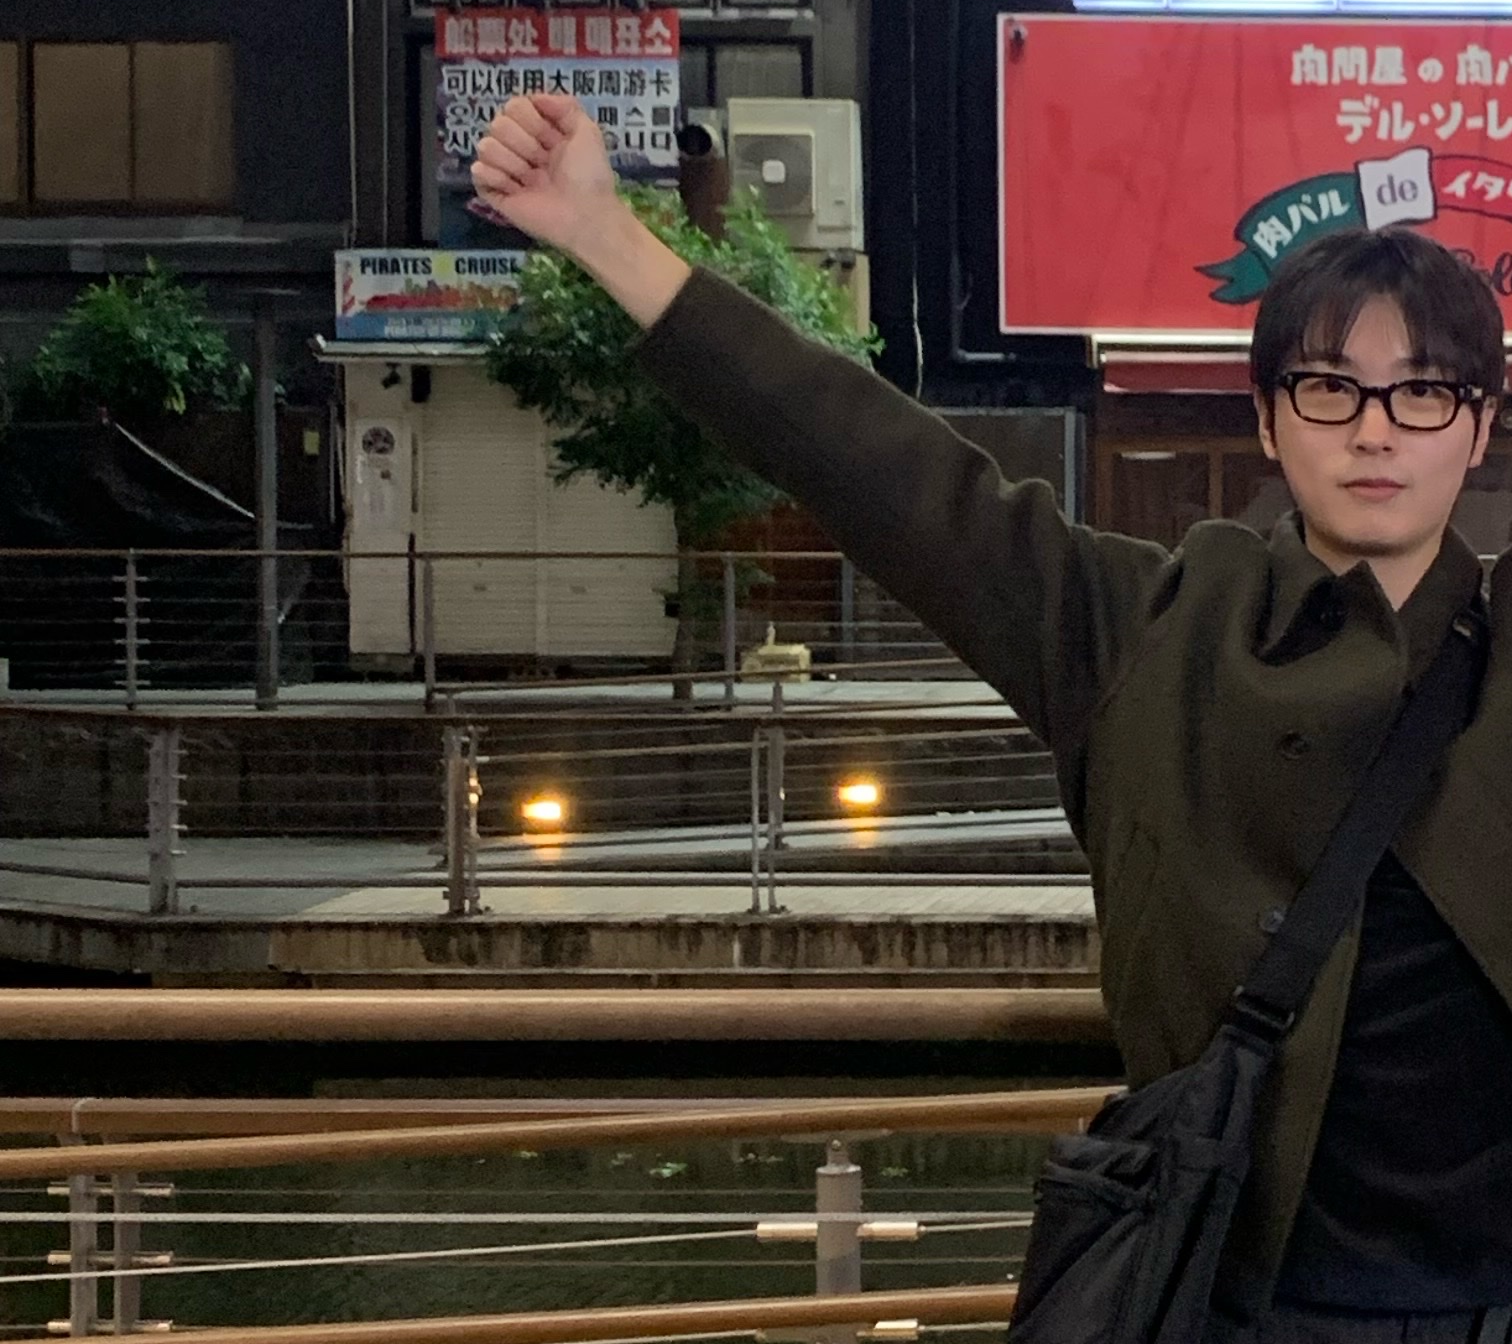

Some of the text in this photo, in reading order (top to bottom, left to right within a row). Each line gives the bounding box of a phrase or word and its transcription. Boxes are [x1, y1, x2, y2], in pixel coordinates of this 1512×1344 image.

[446, 69, 672, 97] 可以使用大阪周游卡
[1252, 189, 1350, 257] 肉バル
[1376, 174, 1418, 206] de
[361, 257, 432, 275] PIRATES
